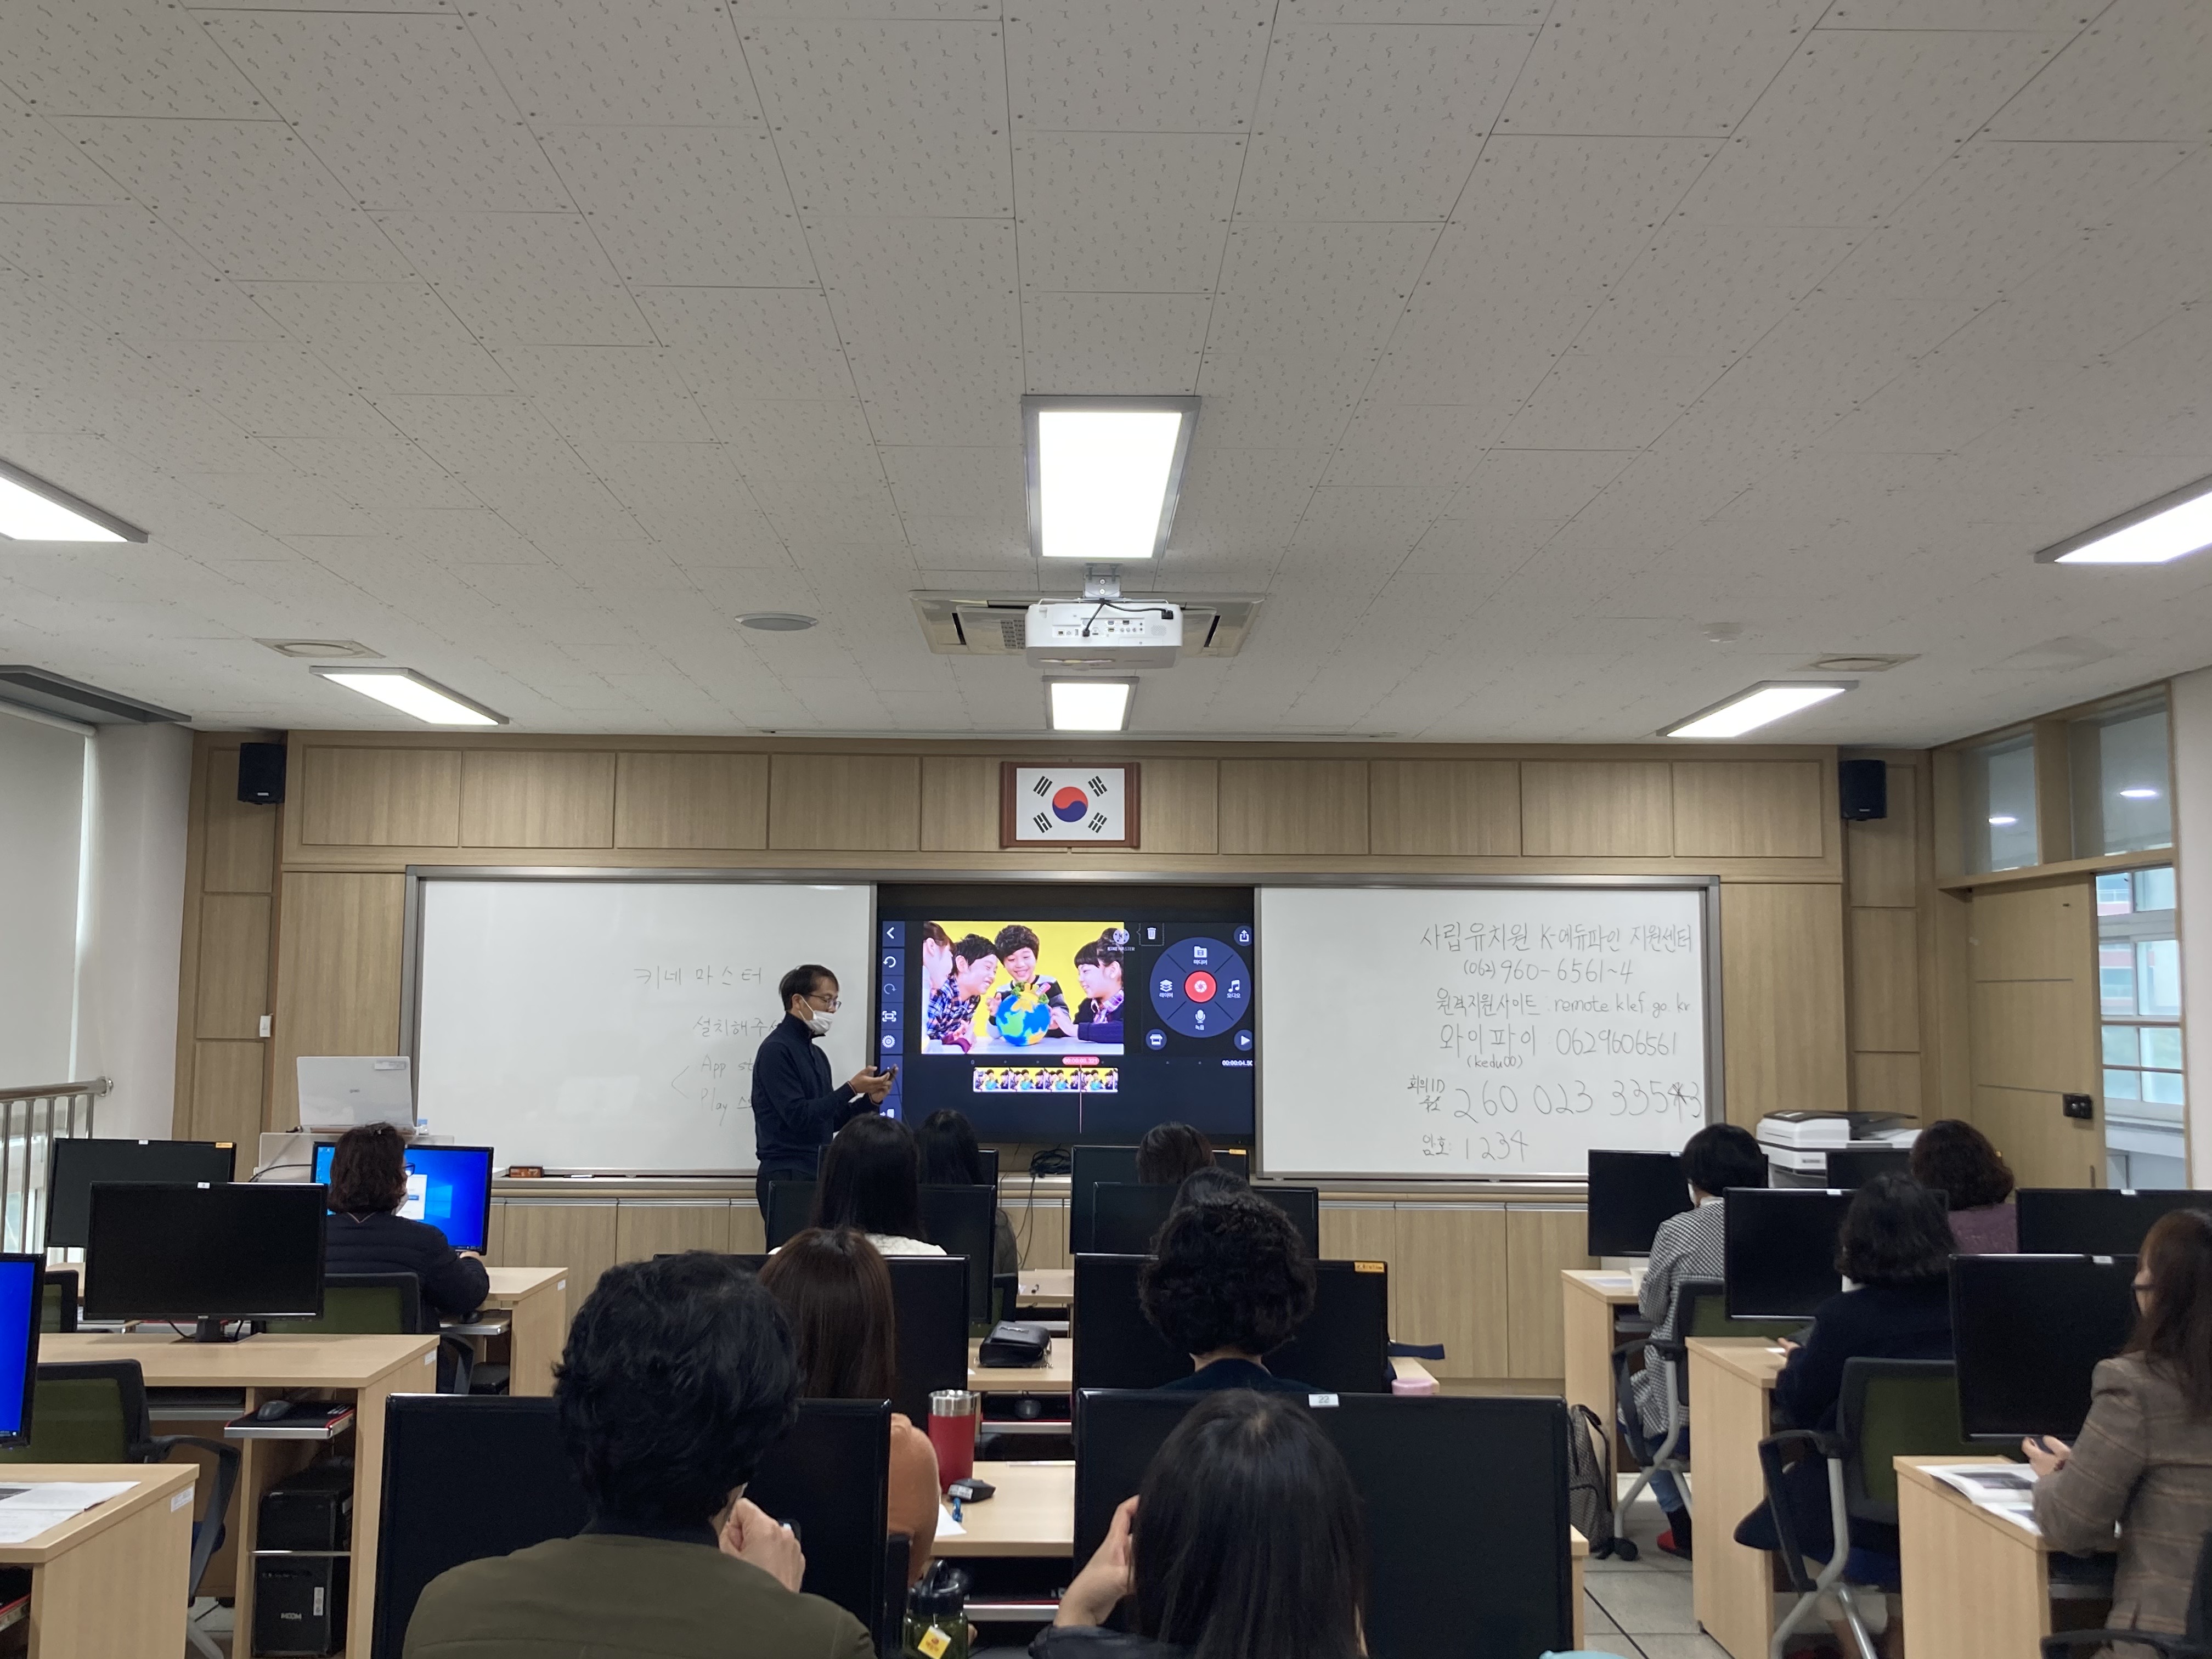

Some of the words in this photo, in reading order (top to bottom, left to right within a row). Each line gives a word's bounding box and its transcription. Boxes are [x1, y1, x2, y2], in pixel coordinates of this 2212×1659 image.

[1541, 924, 1620, 952] K-에듀파인
[1630, 924, 1691, 953] 지원센터
[1556, 1028, 1676, 1056] 0629606561
[702, 1054, 726, 1079] App
[738, 1058, 754, 1071] st
[701, 1088, 727, 1126] Play
[1454, 1080, 1517, 1124] 260
[1533, 1080, 1593, 1114] 023
[1466, 1130, 1528, 1162] 1234
[1318, 1395, 1329, 1403] 22
